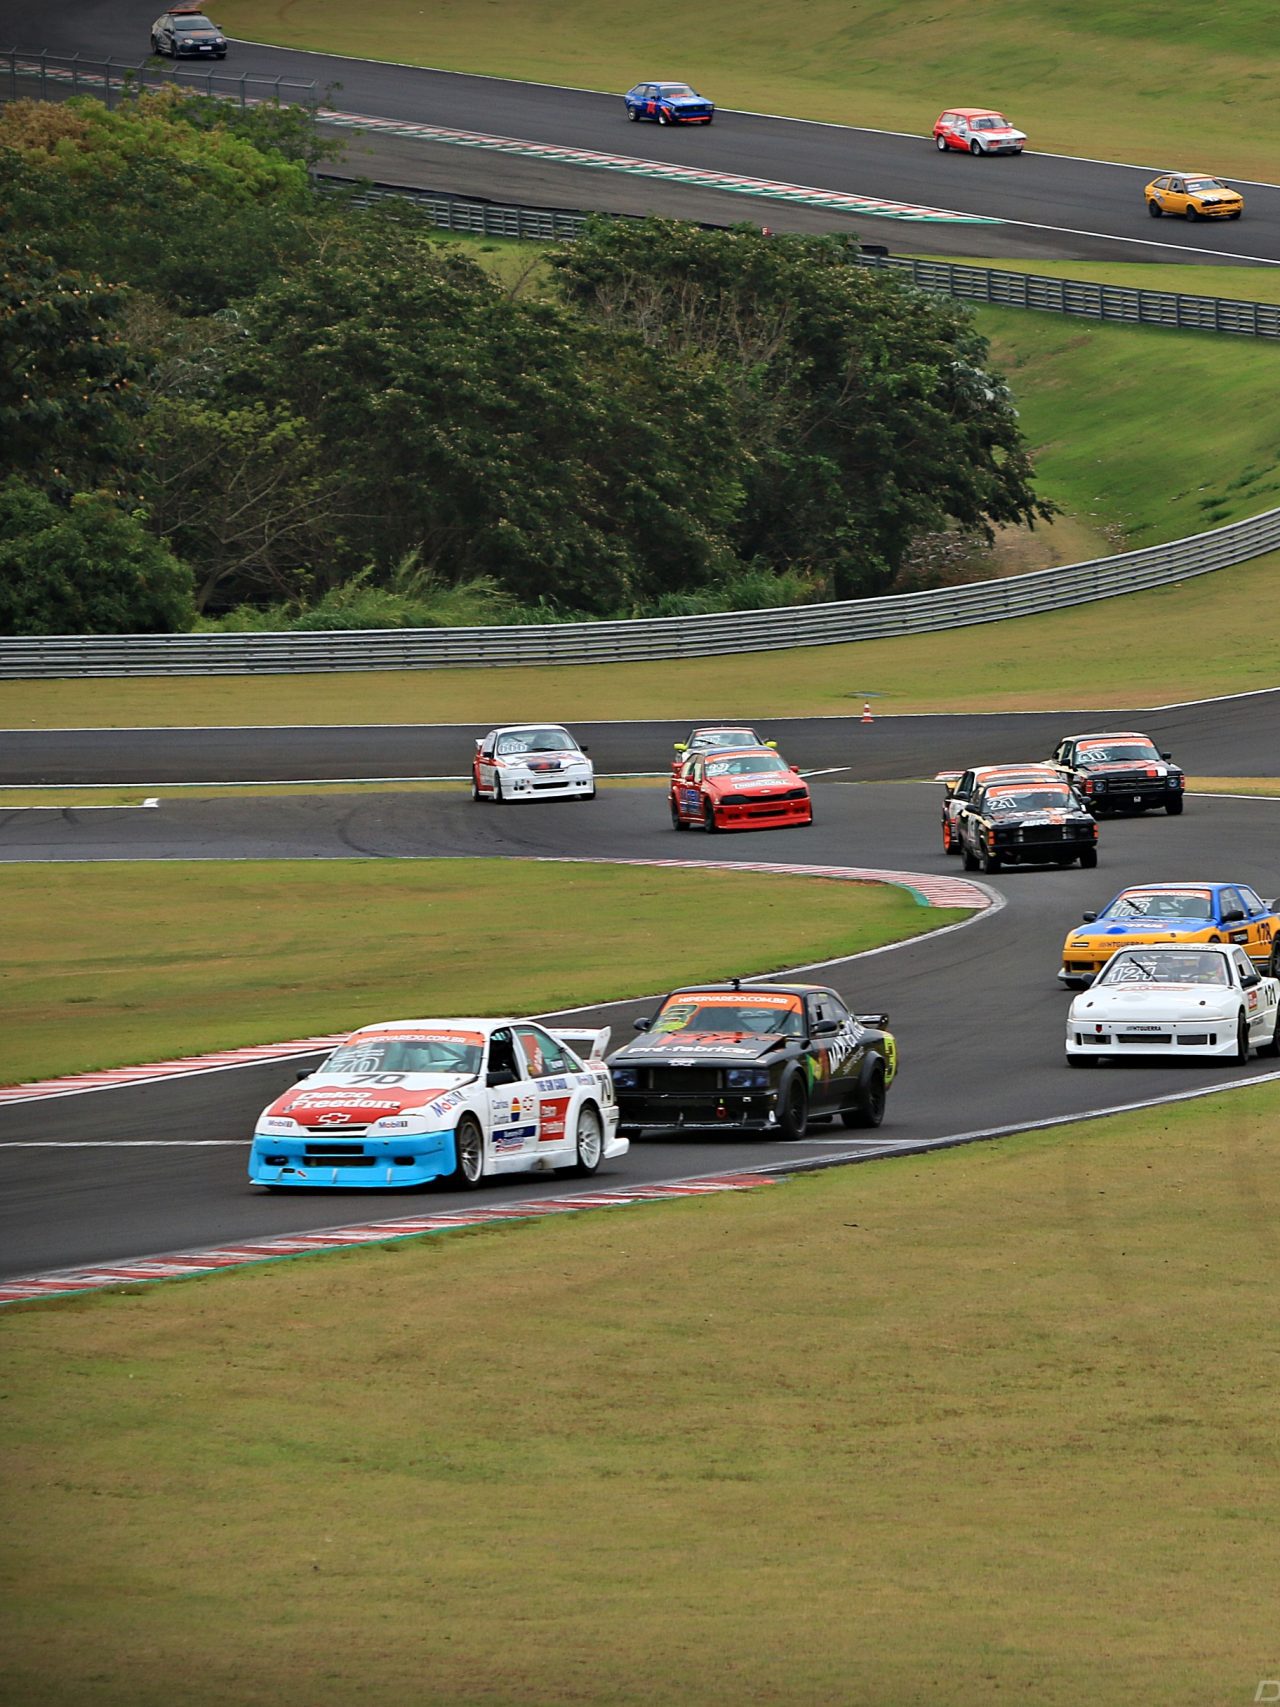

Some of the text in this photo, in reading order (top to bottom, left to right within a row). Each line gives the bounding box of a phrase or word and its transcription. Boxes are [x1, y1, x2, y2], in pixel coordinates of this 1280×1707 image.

[987, 797, 1017, 811] 21
[1110, 966, 1157, 982] 121
[1264, 983, 1276, 1006] 121
[347, 1074, 406, 1084] 70
[291, 1099, 400, 1109] Freedom
